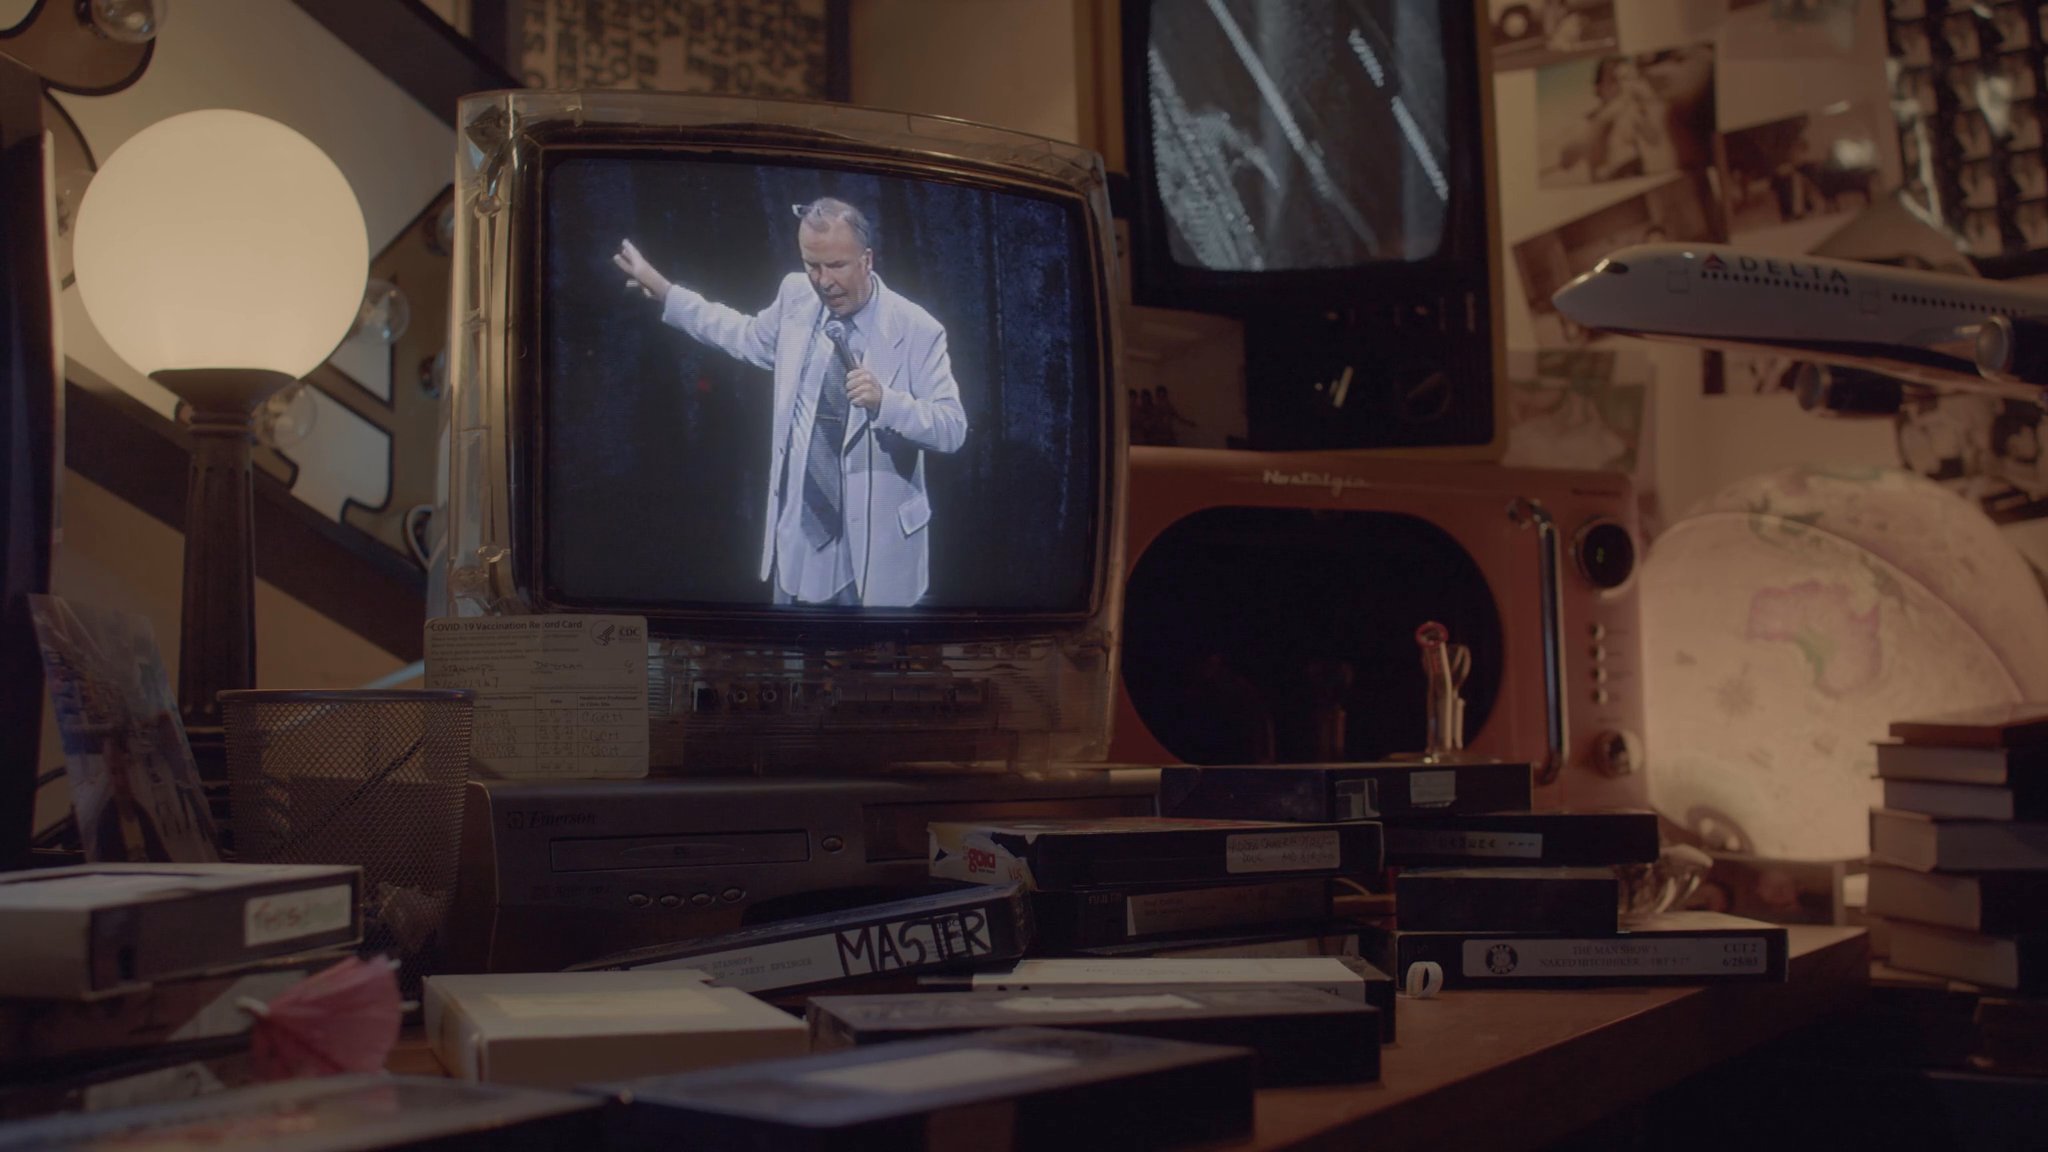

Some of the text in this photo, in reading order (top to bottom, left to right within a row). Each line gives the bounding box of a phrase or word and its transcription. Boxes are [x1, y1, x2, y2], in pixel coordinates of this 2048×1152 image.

[1739, 256, 1848, 283] DELTA
[1262, 469, 1373, 498] Nostalgia
[475, 620, 525, 631] Vaccination
[561, 618, 583, 629] Card
[619, 625, 641, 636] CDC
[528, 810, 599, 828] Emerson
[834, 908, 992, 978] MASTER
[1723, 943, 1748, 953] CUT
